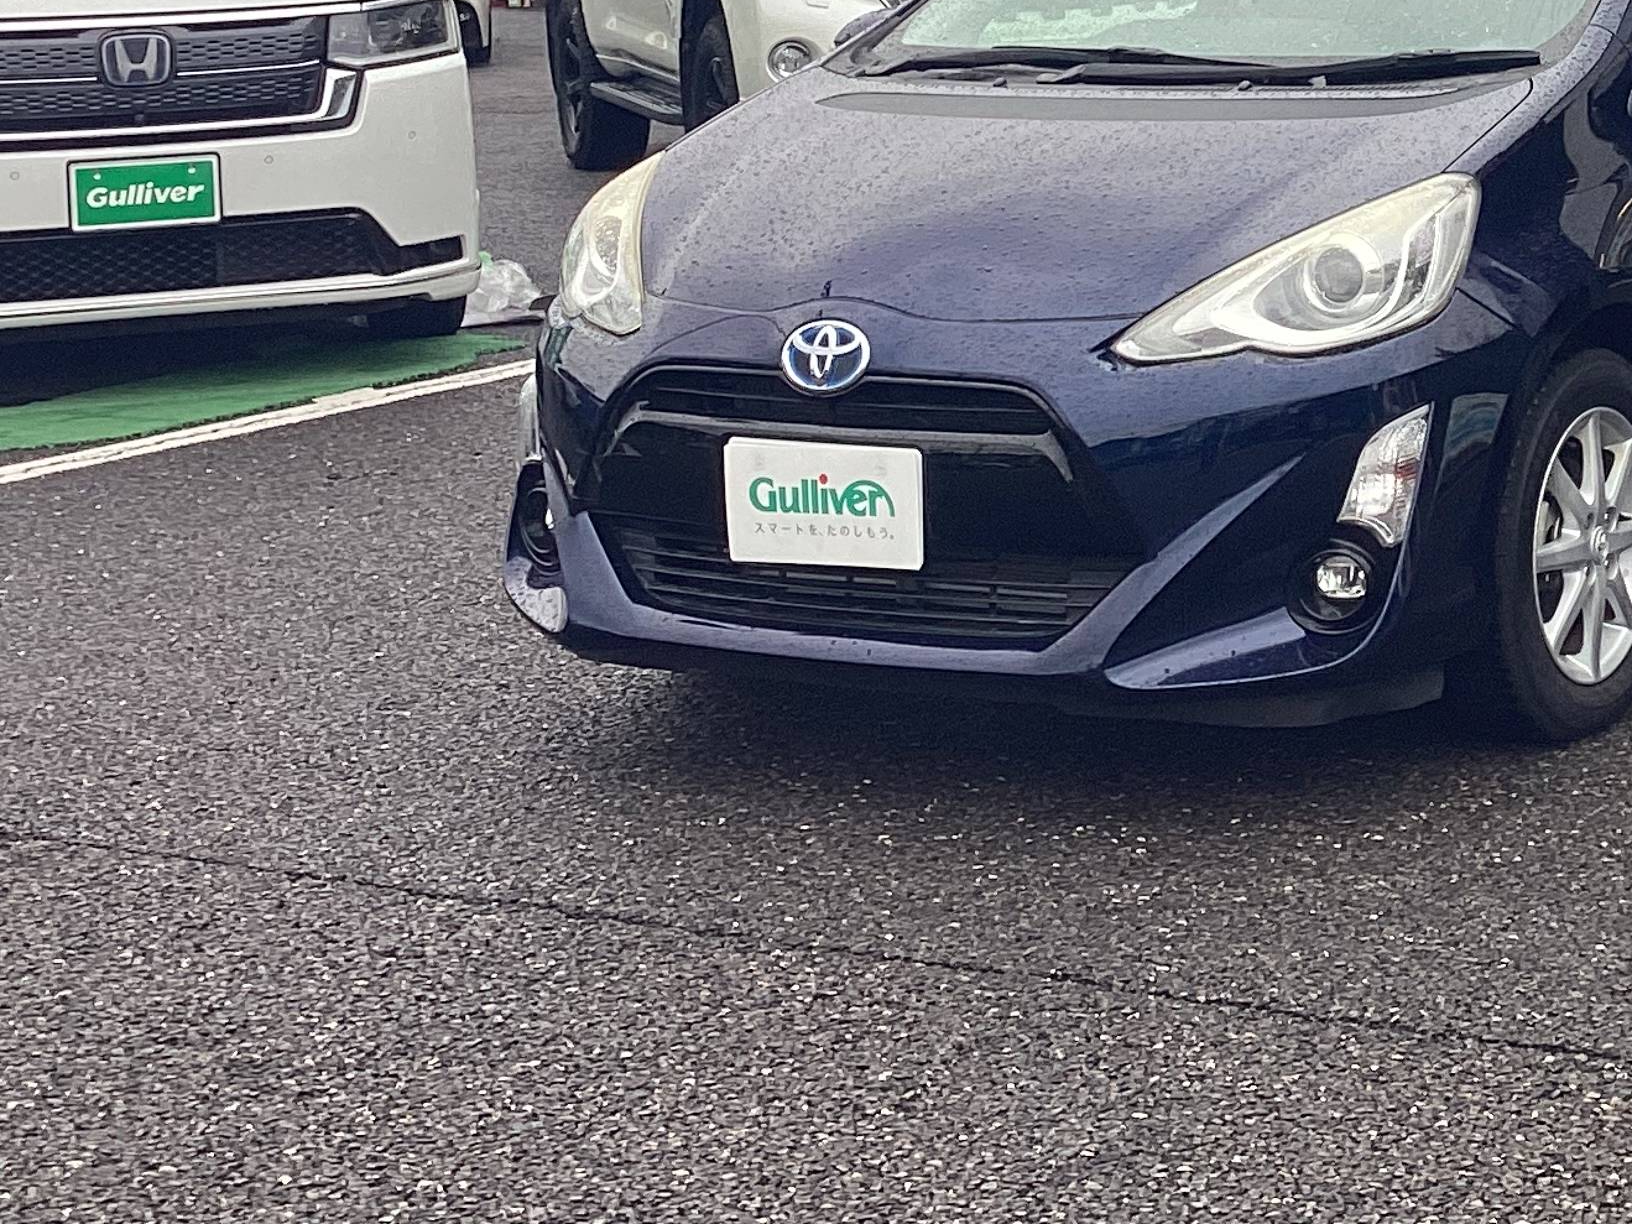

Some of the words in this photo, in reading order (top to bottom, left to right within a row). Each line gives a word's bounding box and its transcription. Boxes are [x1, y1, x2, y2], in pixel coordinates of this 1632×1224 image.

[86, 182, 205, 208] Gulliver
[749, 473, 896, 518] Gulliver
[754, 522, 895, 540] スマートを、たのしもう。
